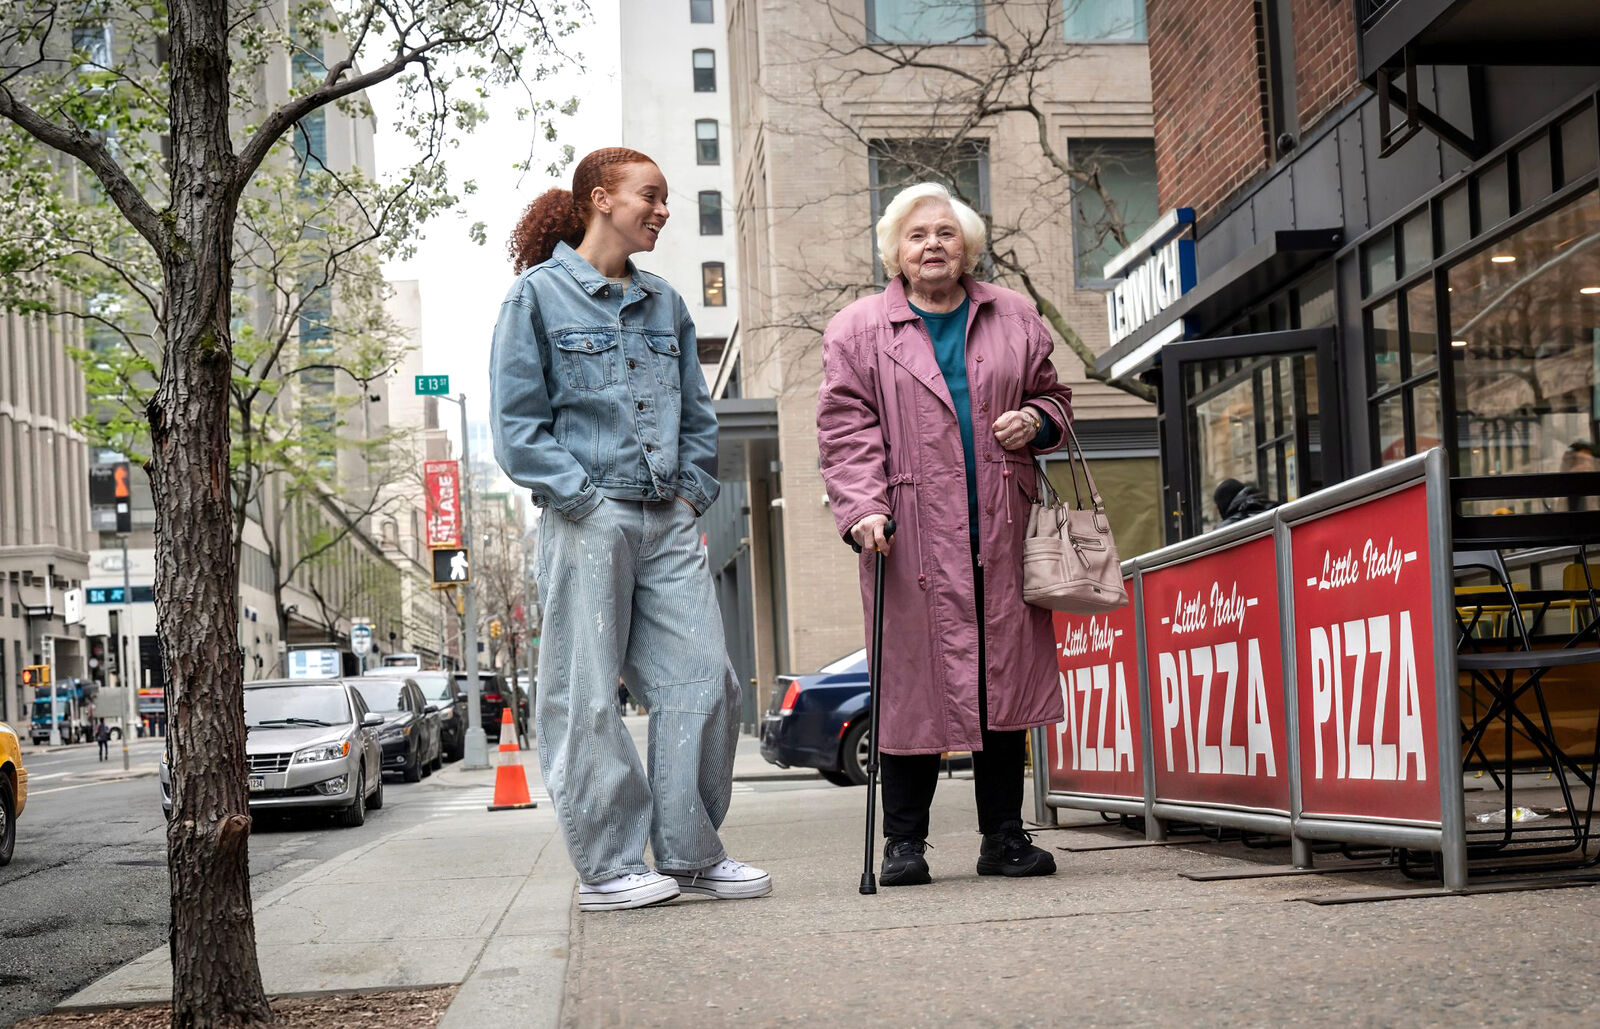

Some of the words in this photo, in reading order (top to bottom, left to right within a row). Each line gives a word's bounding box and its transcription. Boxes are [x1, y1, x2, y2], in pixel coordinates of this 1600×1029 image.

[1106, 238, 1181, 347] LENWICH
[418, 378, 424, 391] E
[428, 378, 438, 391] 13
[1055, 661, 1135, 773] PIZZA
[1158, 638, 1277, 777] PIZZA
[1309, 610, 1427, 781] PIZZA
